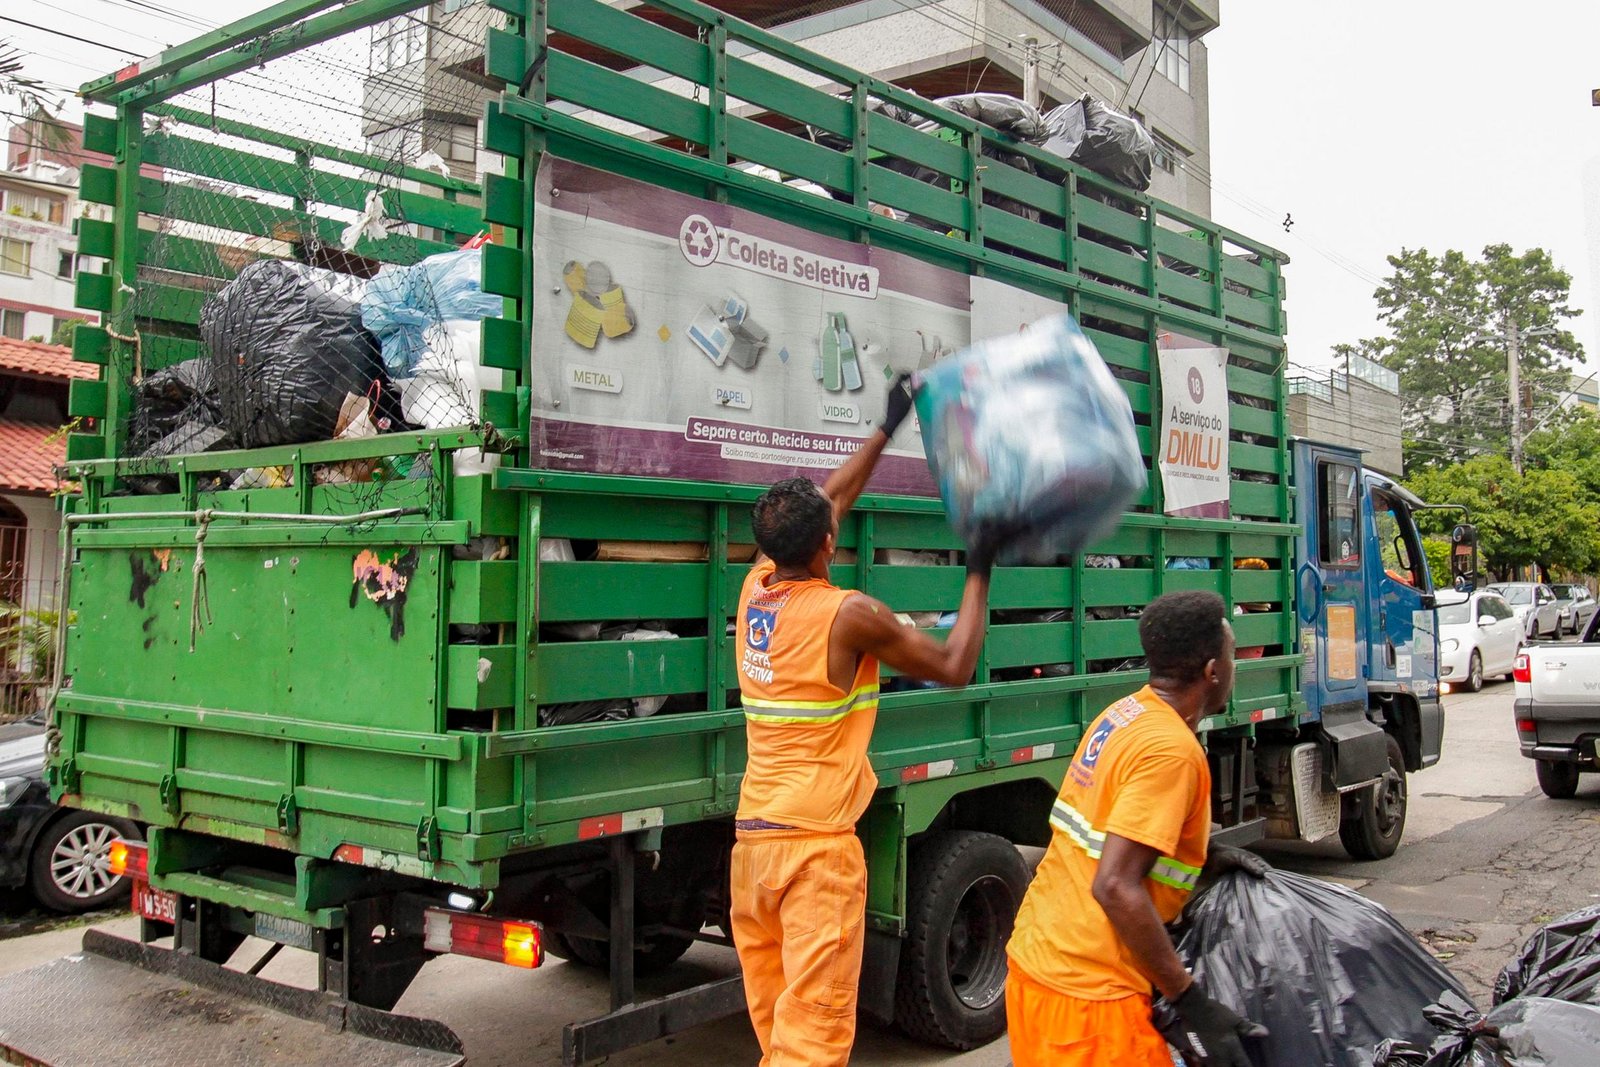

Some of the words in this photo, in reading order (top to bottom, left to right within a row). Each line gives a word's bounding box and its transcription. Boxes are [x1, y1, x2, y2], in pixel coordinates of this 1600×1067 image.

[726, 236, 788, 274] Coleta
[793, 256, 870, 292] Seletiva
[573, 369, 614, 387] METAL
[1190, 378, 1201, 394] 18
[716, 388, 746, 404] PAPEL
[823, 404, 853, 419] VIDRO
[1170, 406, 1178, 422] A
[1179, 410, 1210, 432] serviço
[1211, 414, 1222, 431] do
[692, 422, 736, 441] Separe
[738, 431, 769, 445] certo.
[772, 432, 810, 449] Recicle
[812, 439, 833, 451] seu
[725, 447, 744, 457] Saiba
[1168, 430, 1221, 470] DMLU
